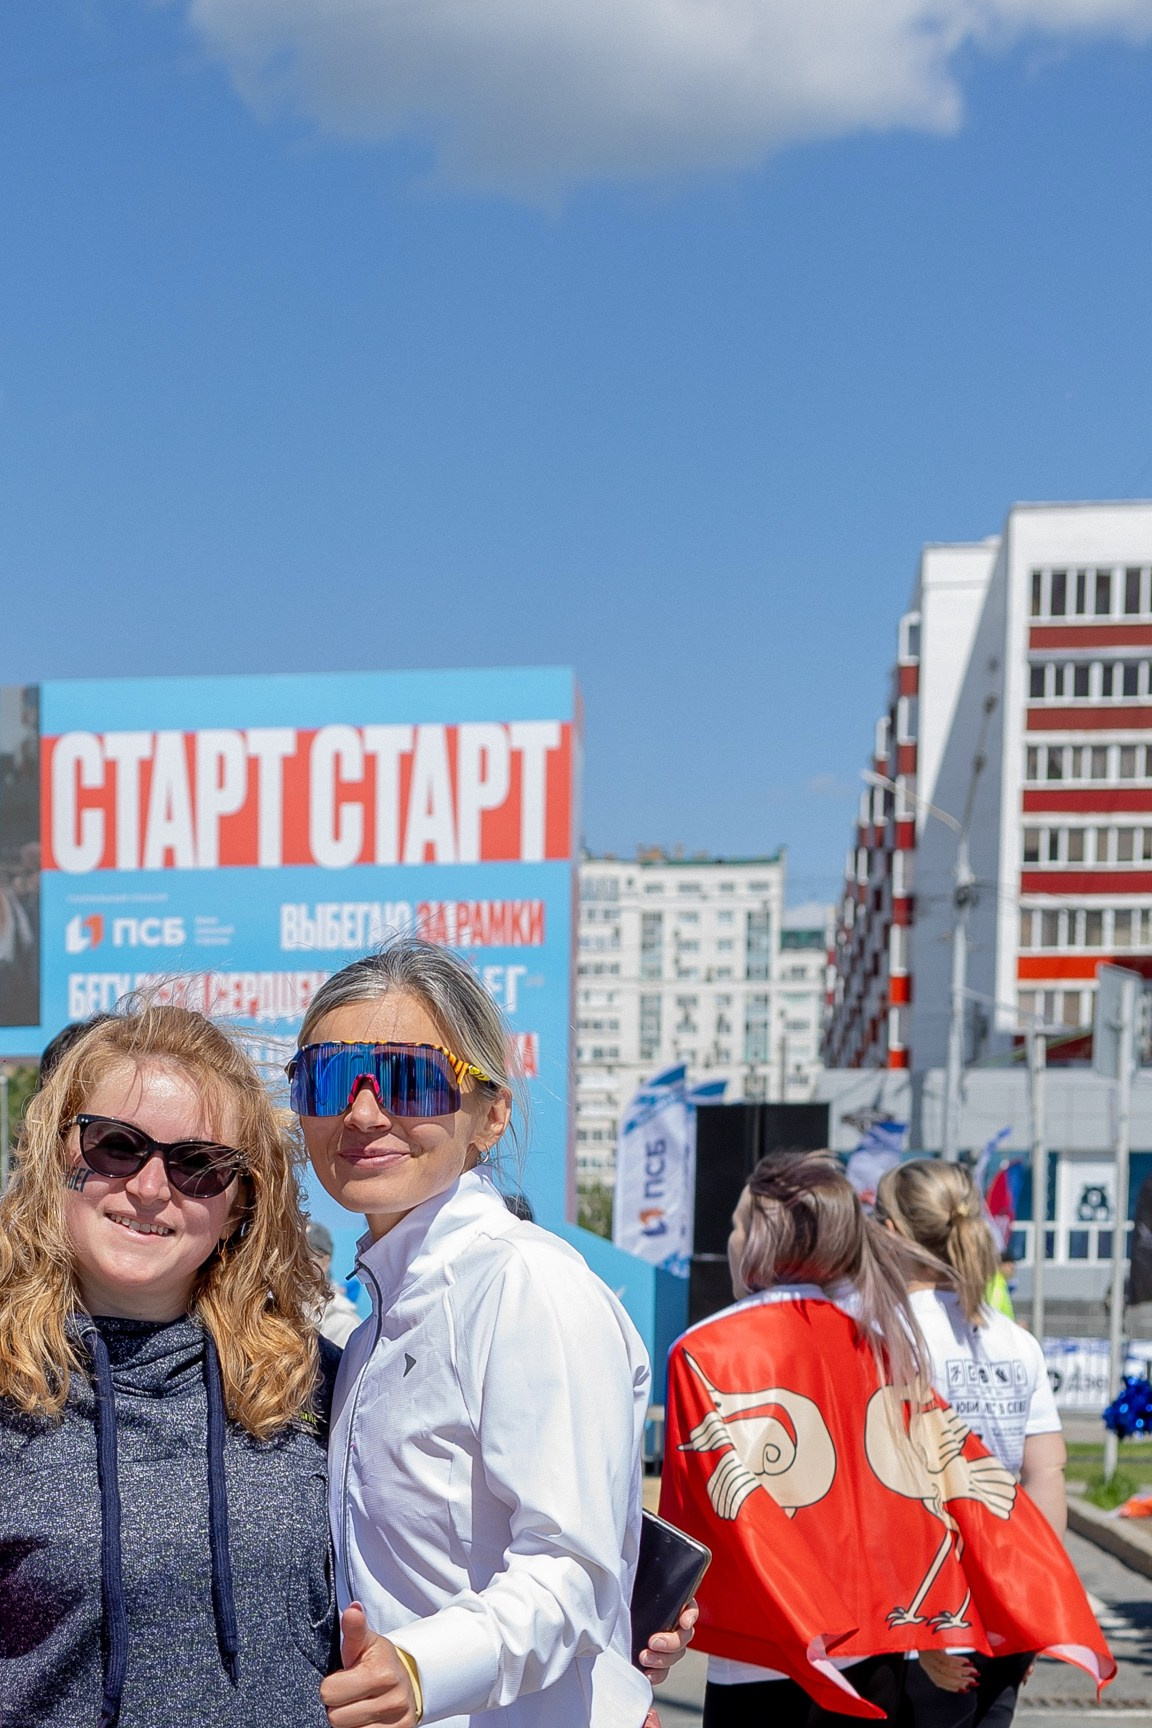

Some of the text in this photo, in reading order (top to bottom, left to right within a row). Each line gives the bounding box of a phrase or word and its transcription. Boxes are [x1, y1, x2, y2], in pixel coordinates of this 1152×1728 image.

[51, 720, 562, 874] СТАРТ СТАРТ
[112, 917, 186, 947] ПСБ
[417, 901, 449, 945] ЗА
[455, 899, 546, 945] РАМКИ
[644, 1137, 667, 1198] ПСБ
